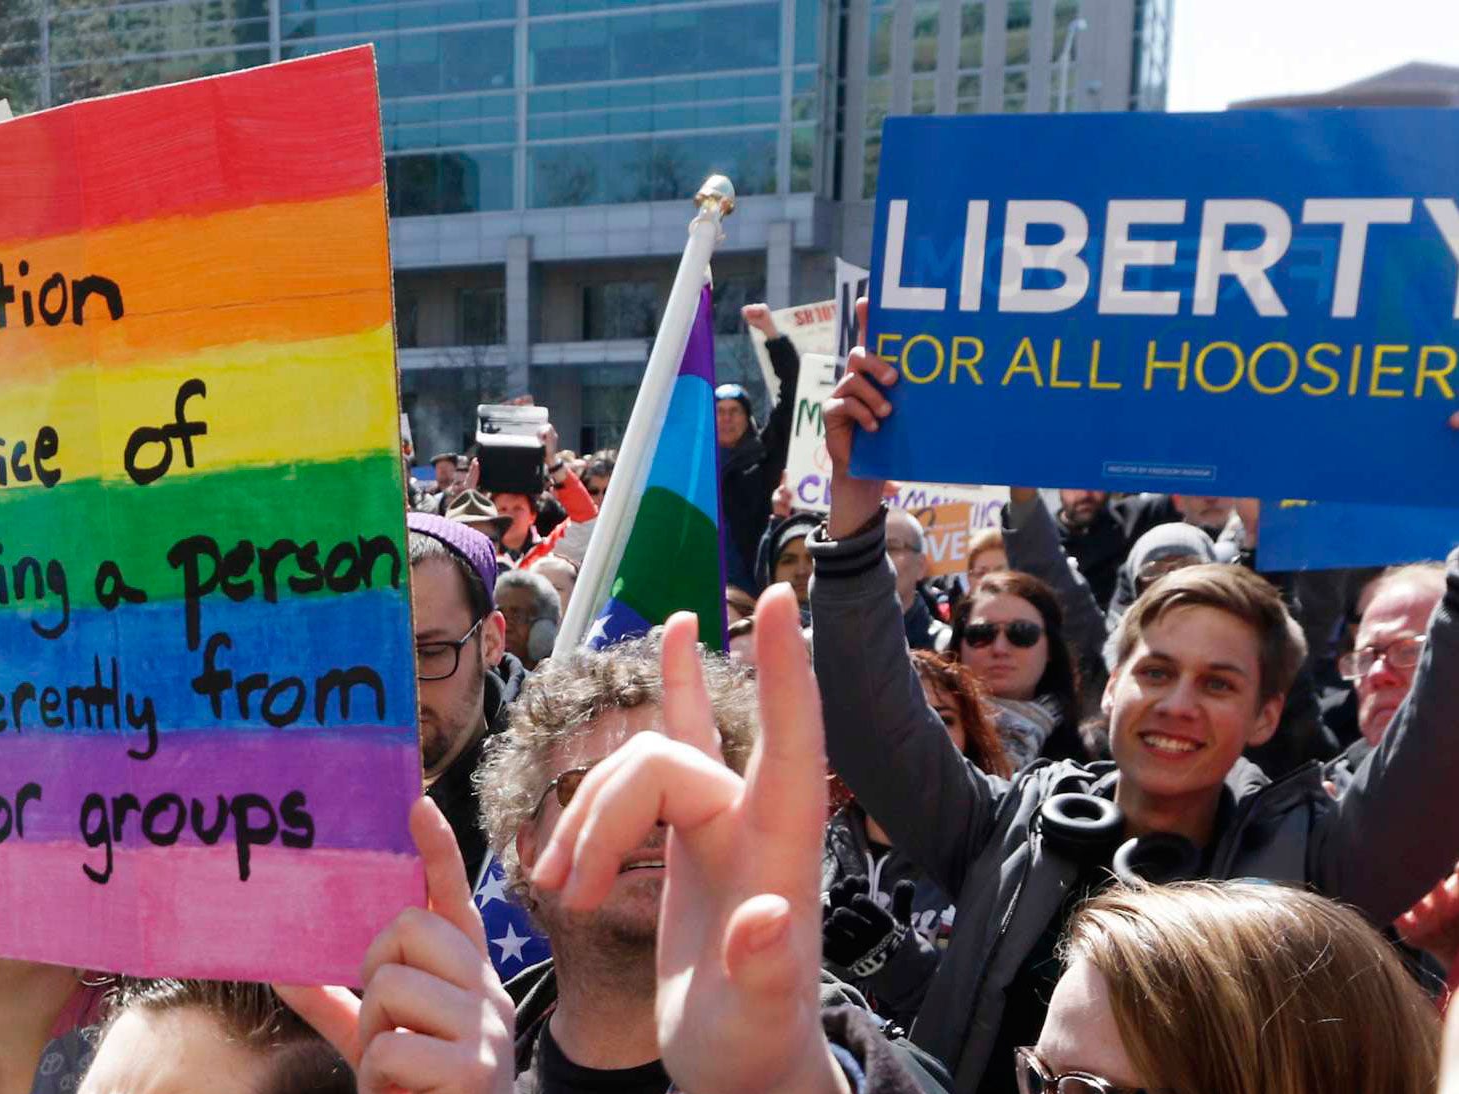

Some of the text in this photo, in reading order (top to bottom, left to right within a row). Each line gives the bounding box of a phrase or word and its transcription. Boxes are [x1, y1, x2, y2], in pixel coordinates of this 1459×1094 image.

[876, 333, 985, 386] FOR
[1000, 336, 1123, 391] ALL
[124, 378, 208, 485] of
[95, 560, 148, 611] a
[167, 534, 401, 651] person
[191, 632, 386, 728] from
[80, 789, 316, 884] groups
